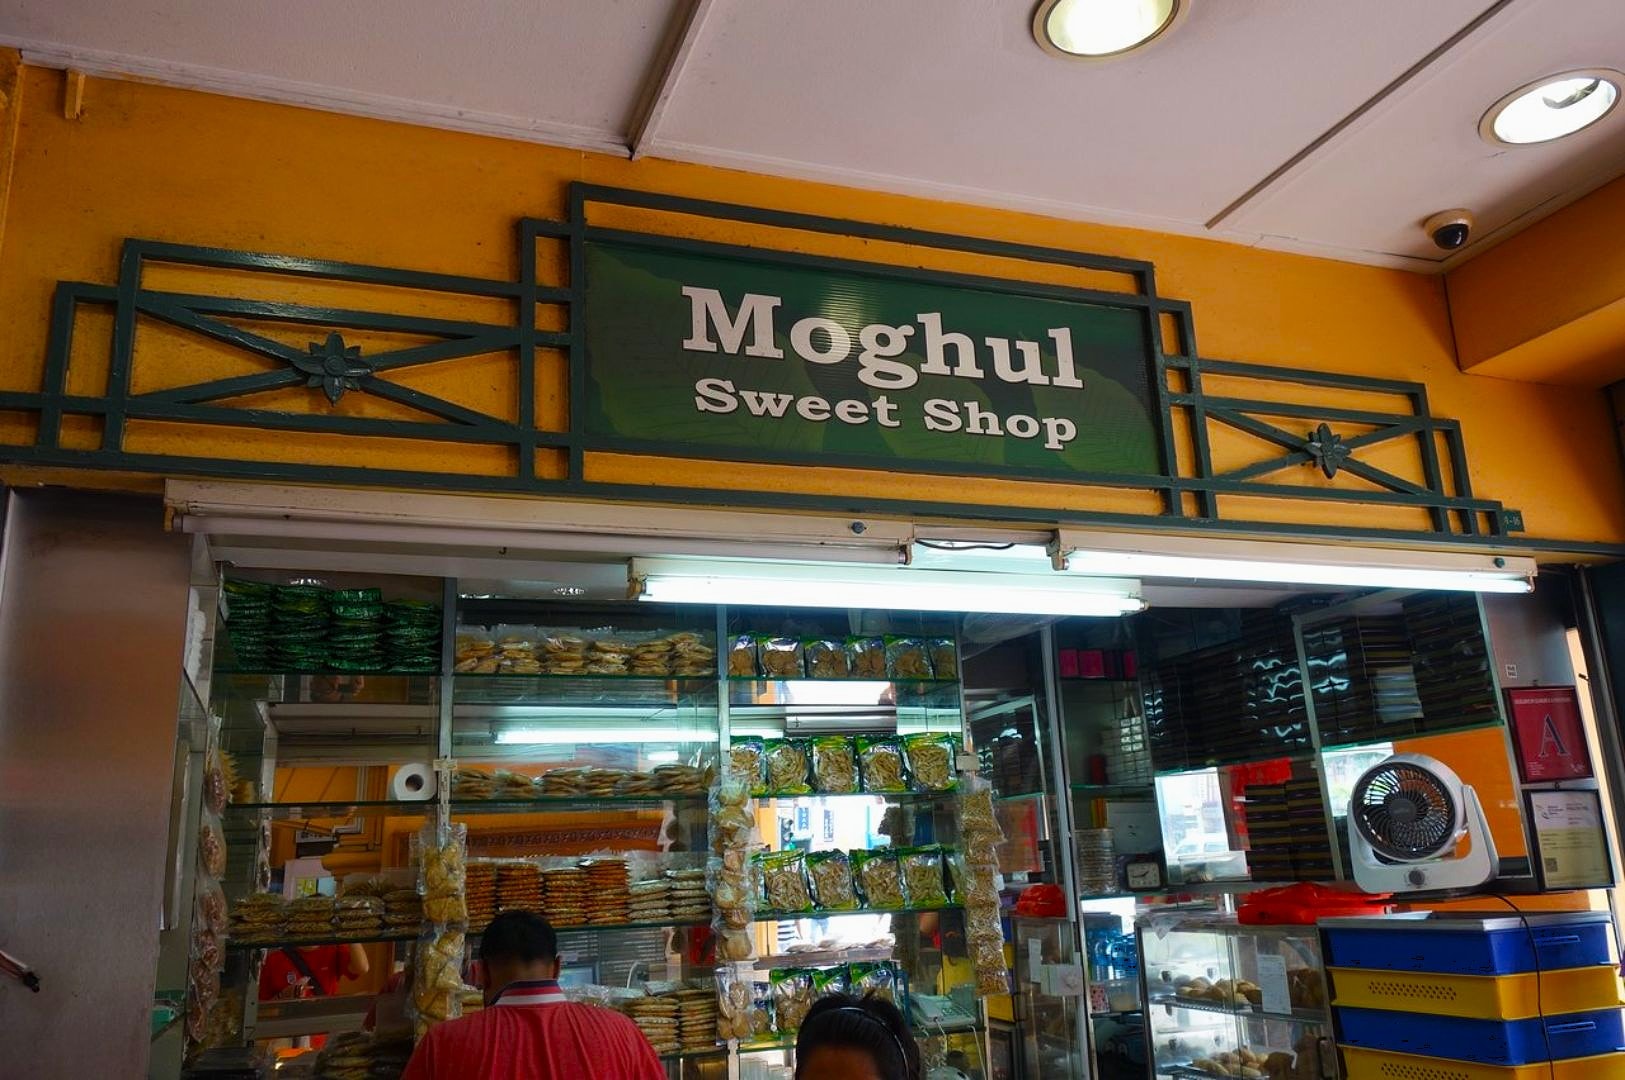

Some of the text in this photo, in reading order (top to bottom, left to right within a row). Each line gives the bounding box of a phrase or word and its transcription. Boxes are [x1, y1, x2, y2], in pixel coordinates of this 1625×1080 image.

[682, 285, 1084, 390] Moghul
[694, 377, 1078, 450] Sweet Shop
[1538, 713, 1571, 758] A
